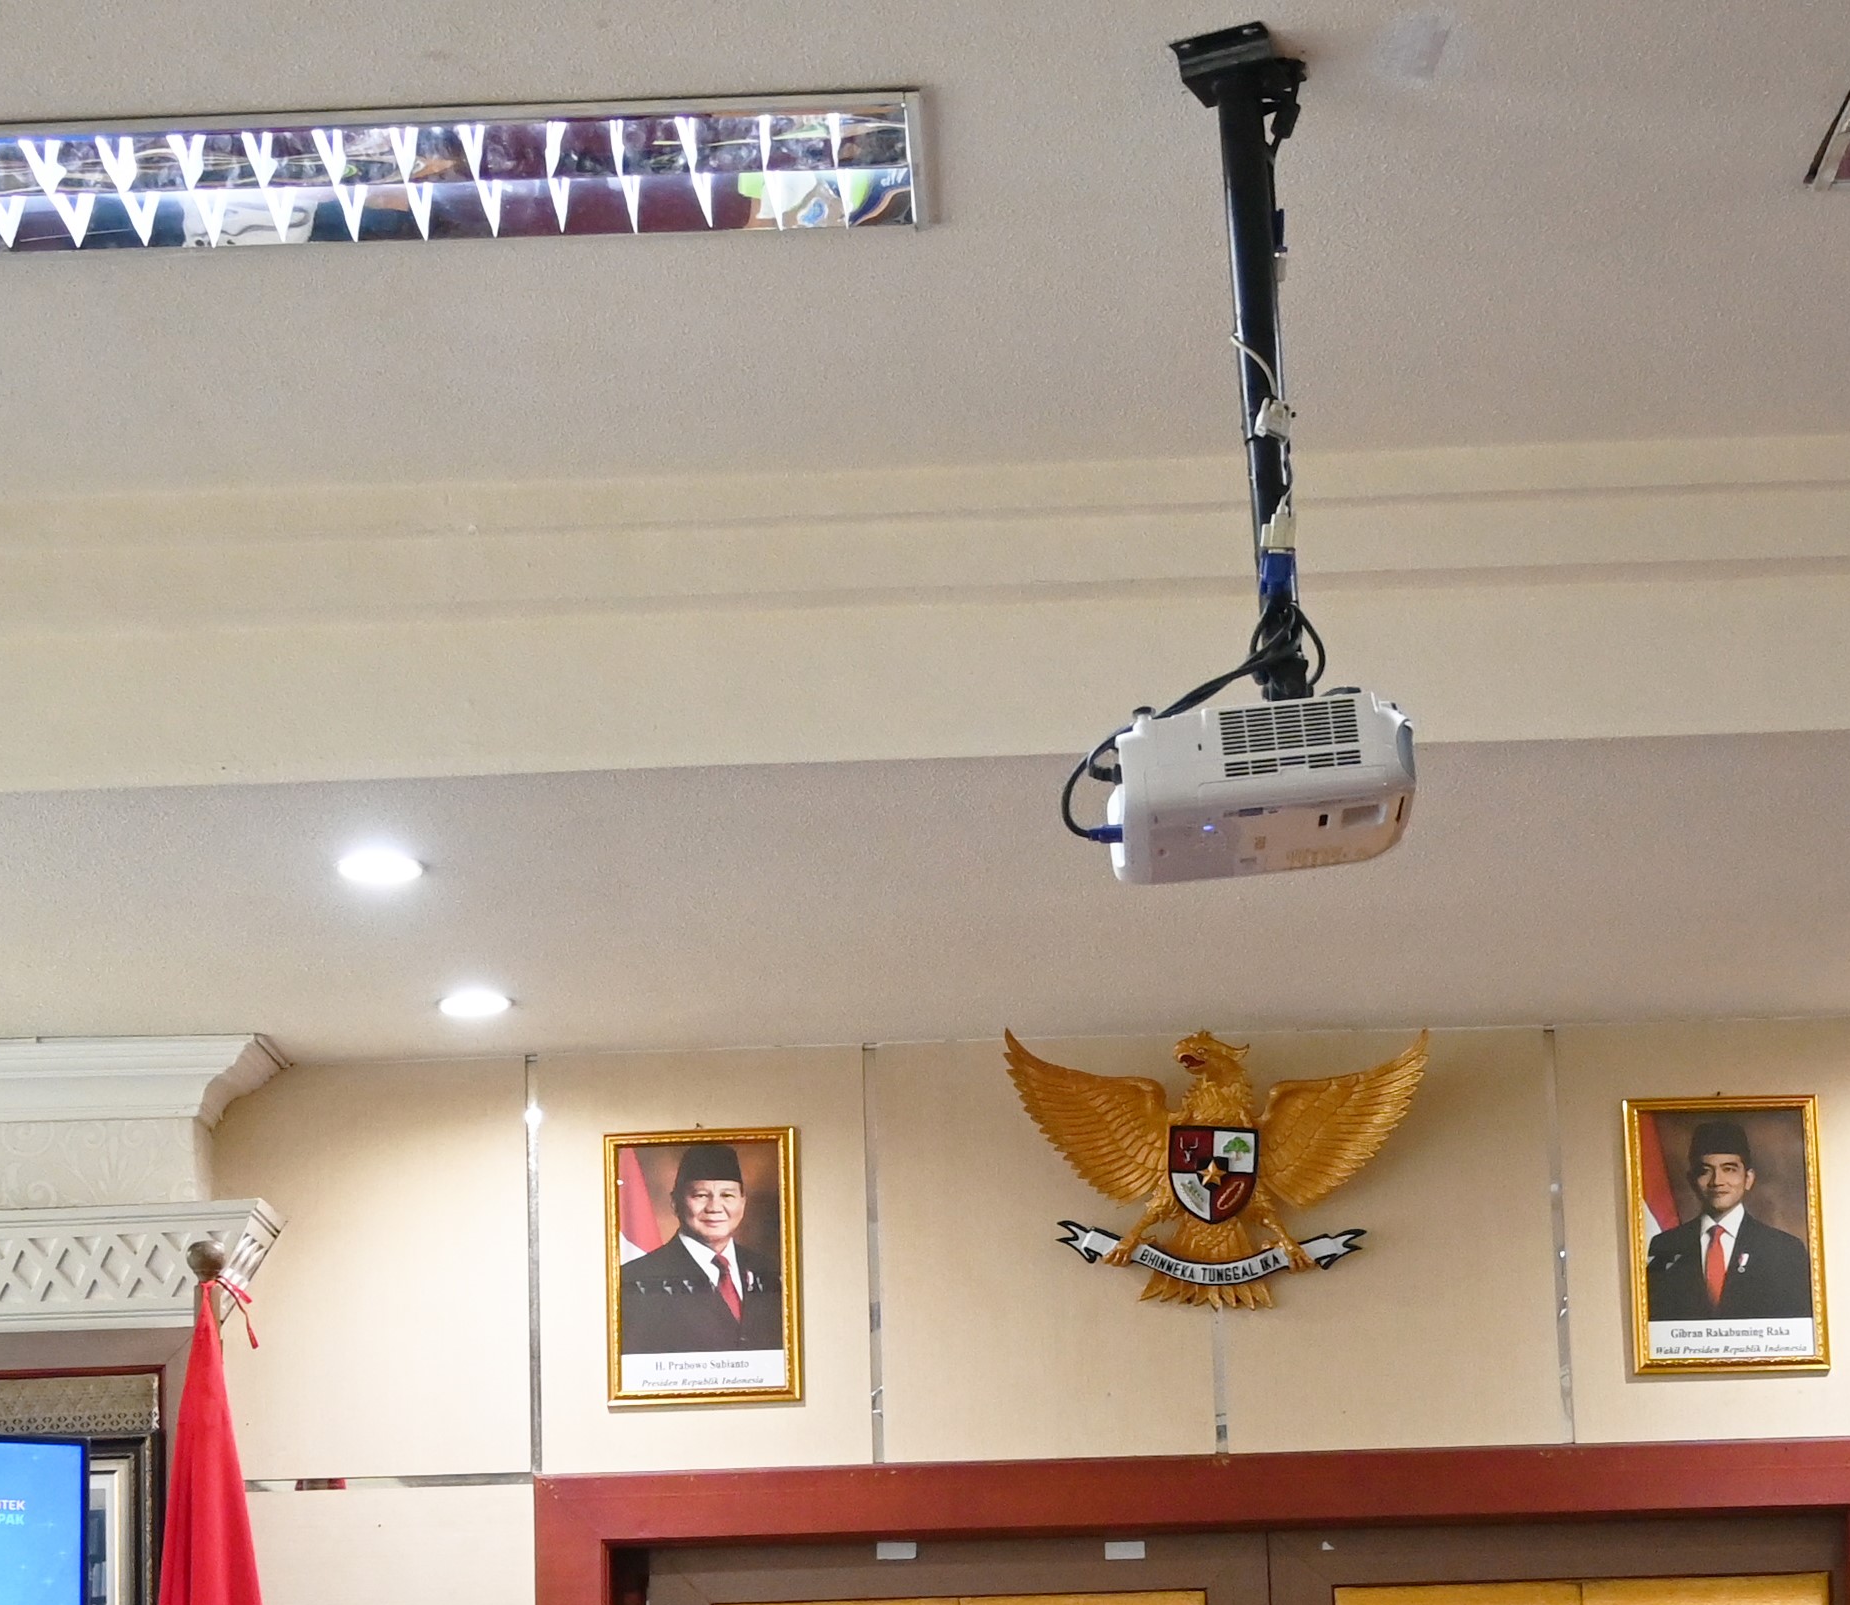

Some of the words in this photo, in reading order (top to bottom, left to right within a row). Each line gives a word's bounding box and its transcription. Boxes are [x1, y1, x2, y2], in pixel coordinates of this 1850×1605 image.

[1201, 1262, 1258, 1282] TUNGGAL
[1260, 1254, 1281, 1271] IKA
[1671, 1328, 1703, 1338] Gibran
[1706, 1326, 1764, 1339] Rakabuming
[1767, 1327, 1790, 1337] Raka
[1656, 1346, 1680, 1355] Wakil
[1683, 1345, 1720, 1355] Presiden
[1723, 1344, 1762, 1356] Republik
[1765, 1343, 1807, 1353] Indonesia
[668, 1360, 708, 1371] Prabowo
[710, 1358, 749, 1370] Subianto
[642, 1378, 678, 1388] Presiden
[681, 1377, 719, 1387] Republik
[722, 1375, 764, 1386] Indonesia
